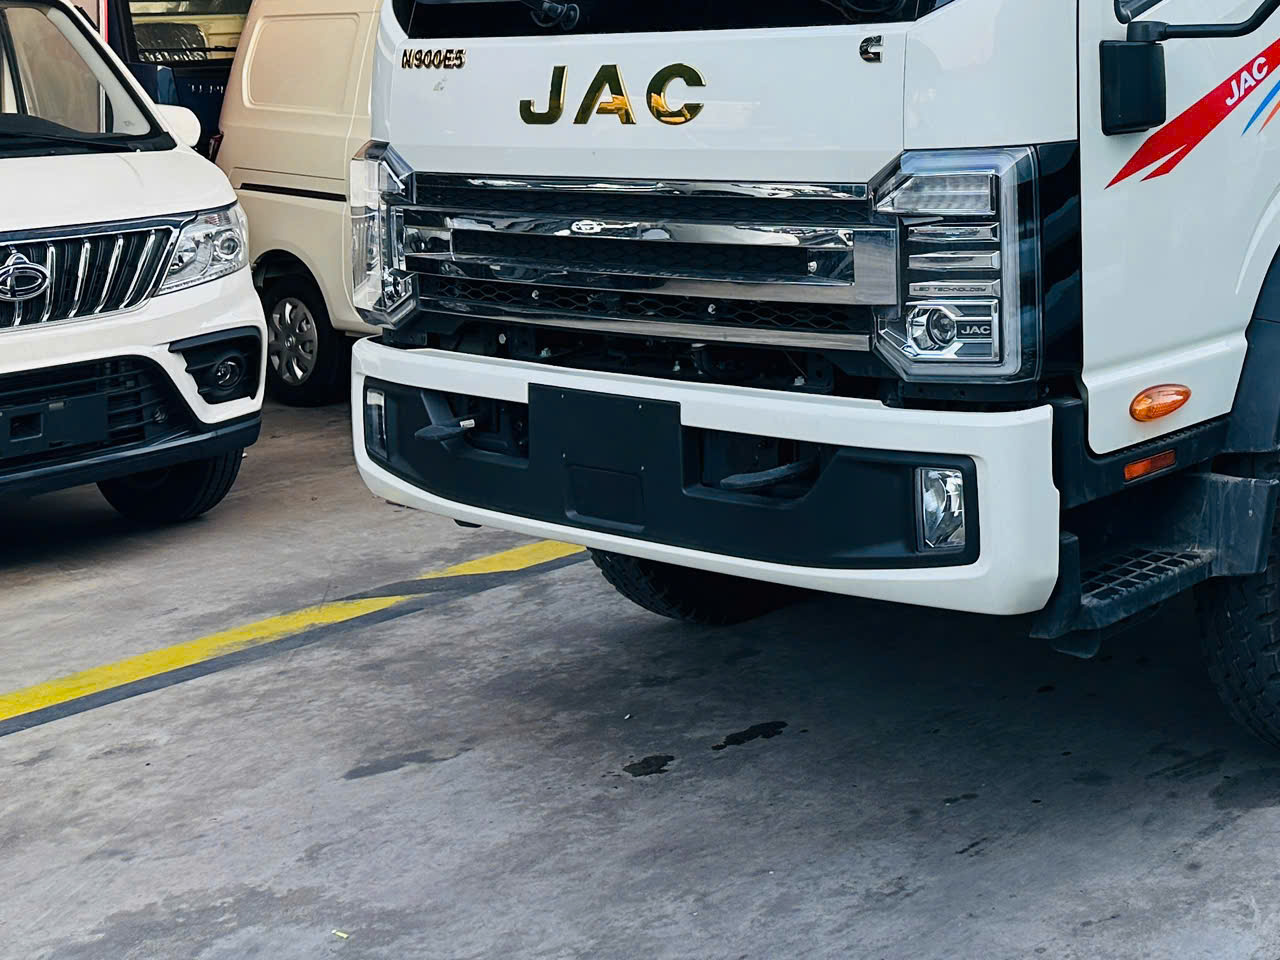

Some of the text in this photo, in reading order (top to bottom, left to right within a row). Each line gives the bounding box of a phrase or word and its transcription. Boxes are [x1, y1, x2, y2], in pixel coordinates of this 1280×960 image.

[402, 48, 467, 69] N900E5
[519, 62, 706, 125] JAC
[1225, 56, 1268, 106] JAC
[961, 325, 991, 334] JAC
